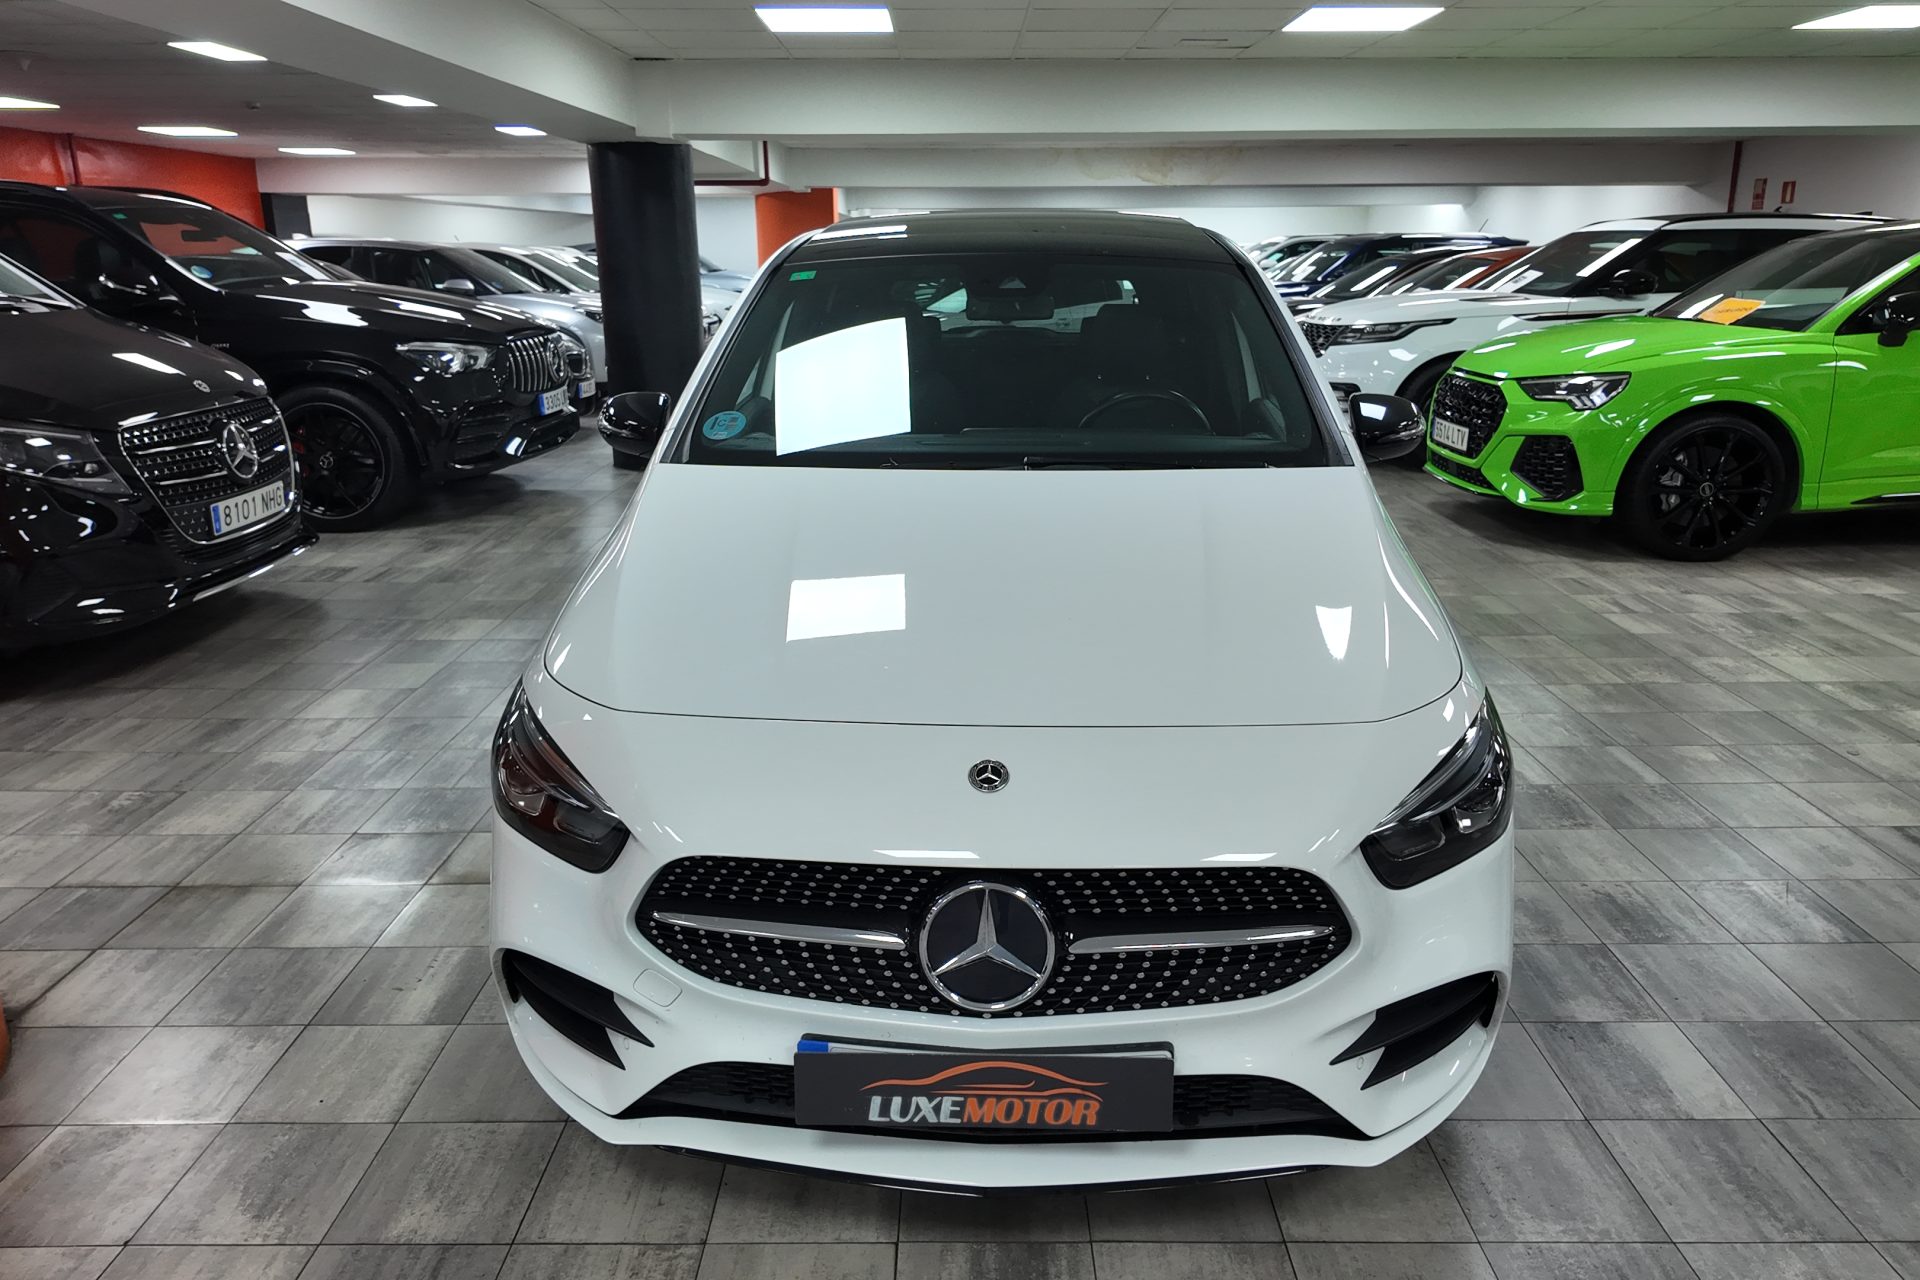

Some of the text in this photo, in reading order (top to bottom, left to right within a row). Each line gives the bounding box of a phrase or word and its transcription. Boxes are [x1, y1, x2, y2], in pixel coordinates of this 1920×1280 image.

[1450, 426, 1467, 448] LTV
[223, 485, 284, 527] 8101 NHG
[868, 1095, 1101, 1126] LUXEMOTOR
